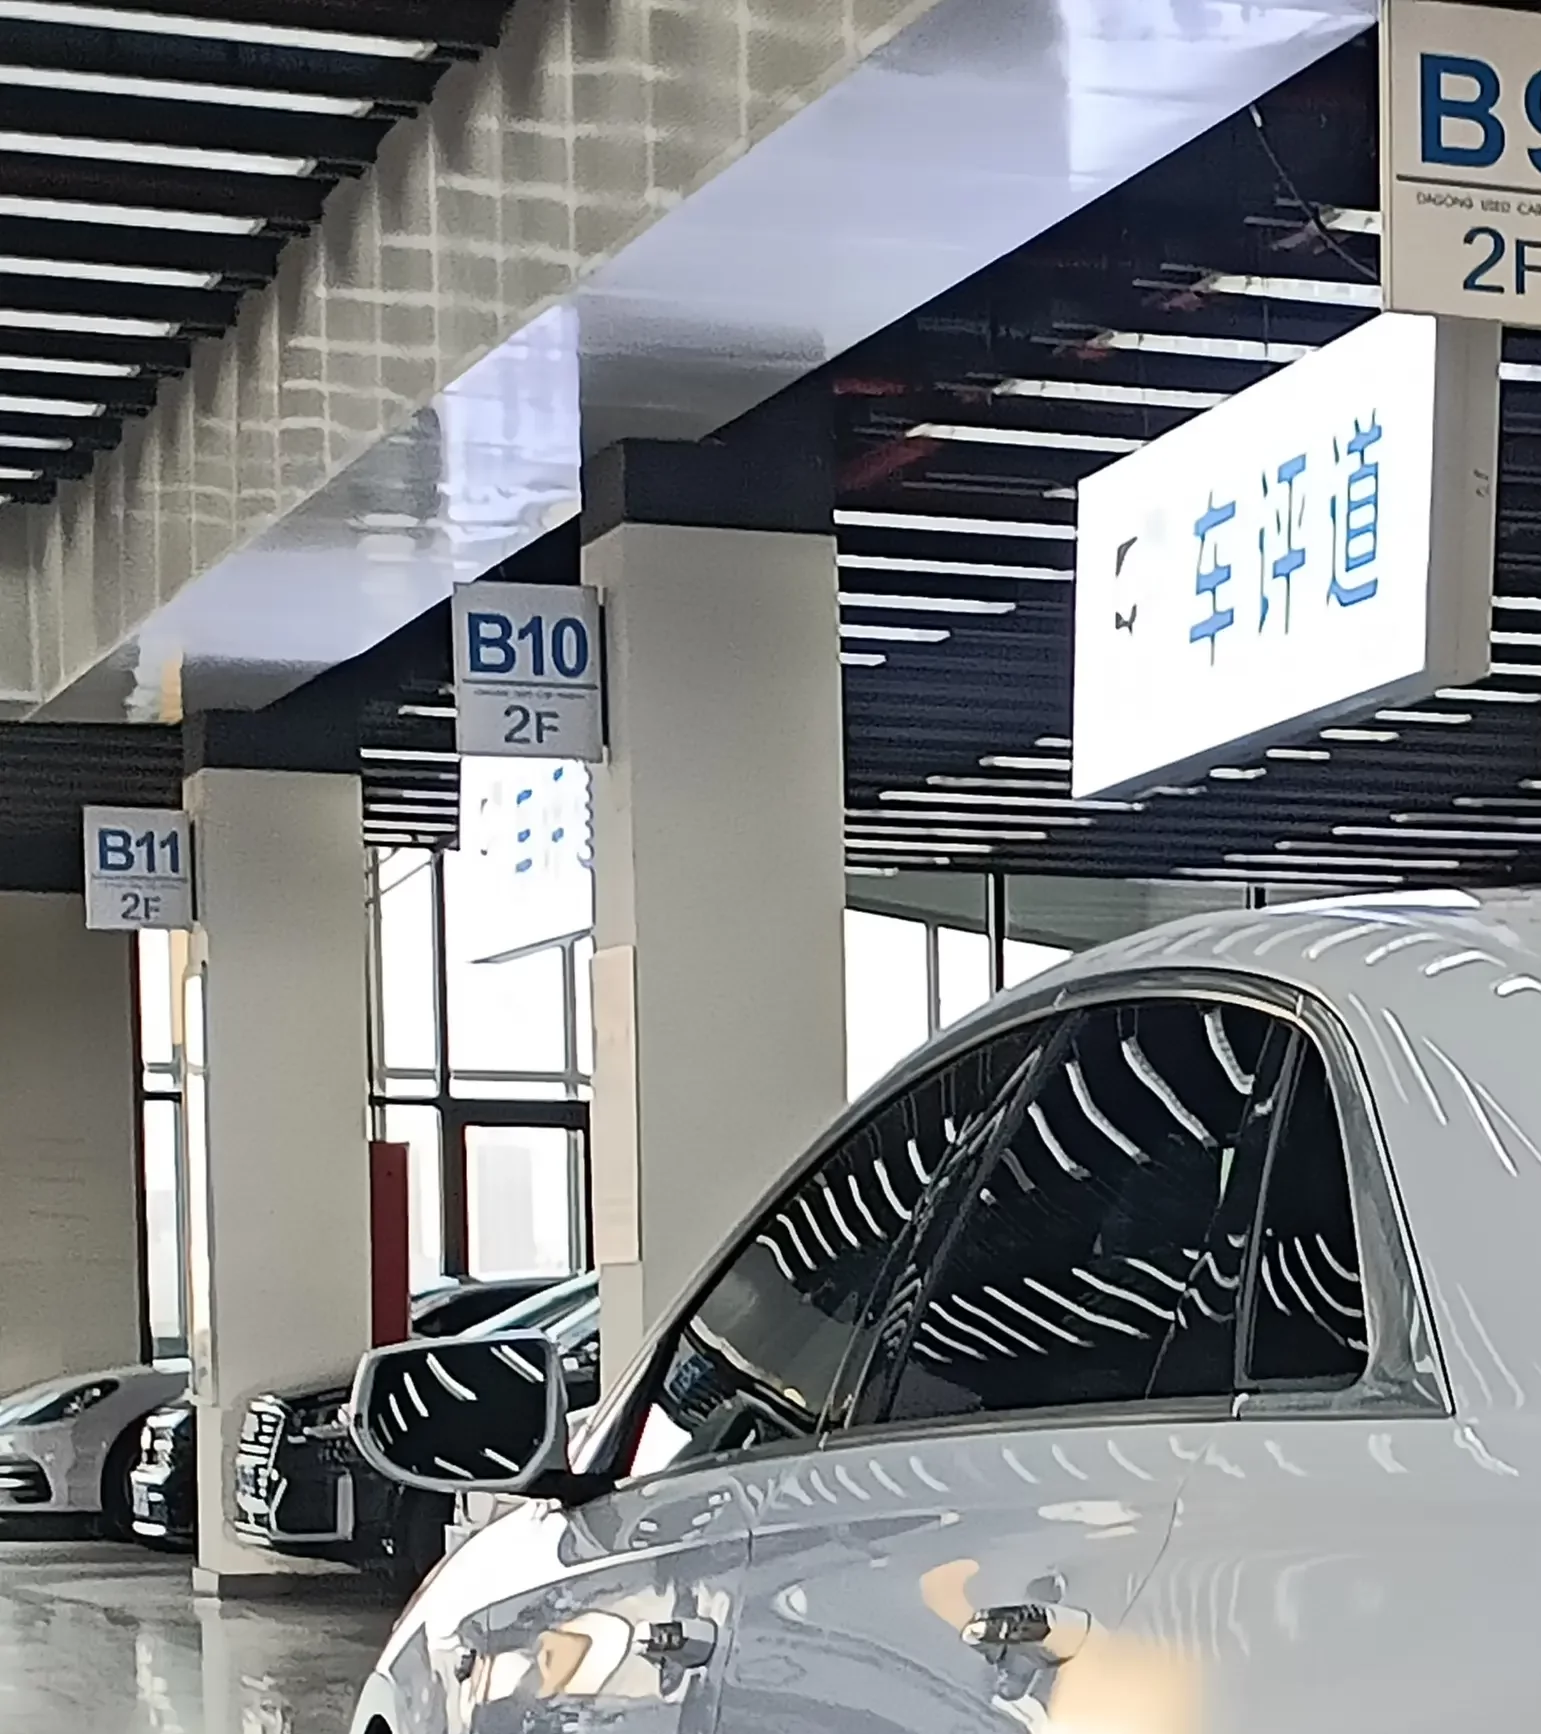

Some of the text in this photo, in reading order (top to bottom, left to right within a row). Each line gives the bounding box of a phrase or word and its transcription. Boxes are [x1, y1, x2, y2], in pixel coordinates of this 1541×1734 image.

[1189, 407, 1383, 667] 车评道
[467, 612, 589, 679] B10
[503, 704, 560, 744] 2F
[98, 827, 180, 874] B11
[121, 892, 162, 921] 2F
